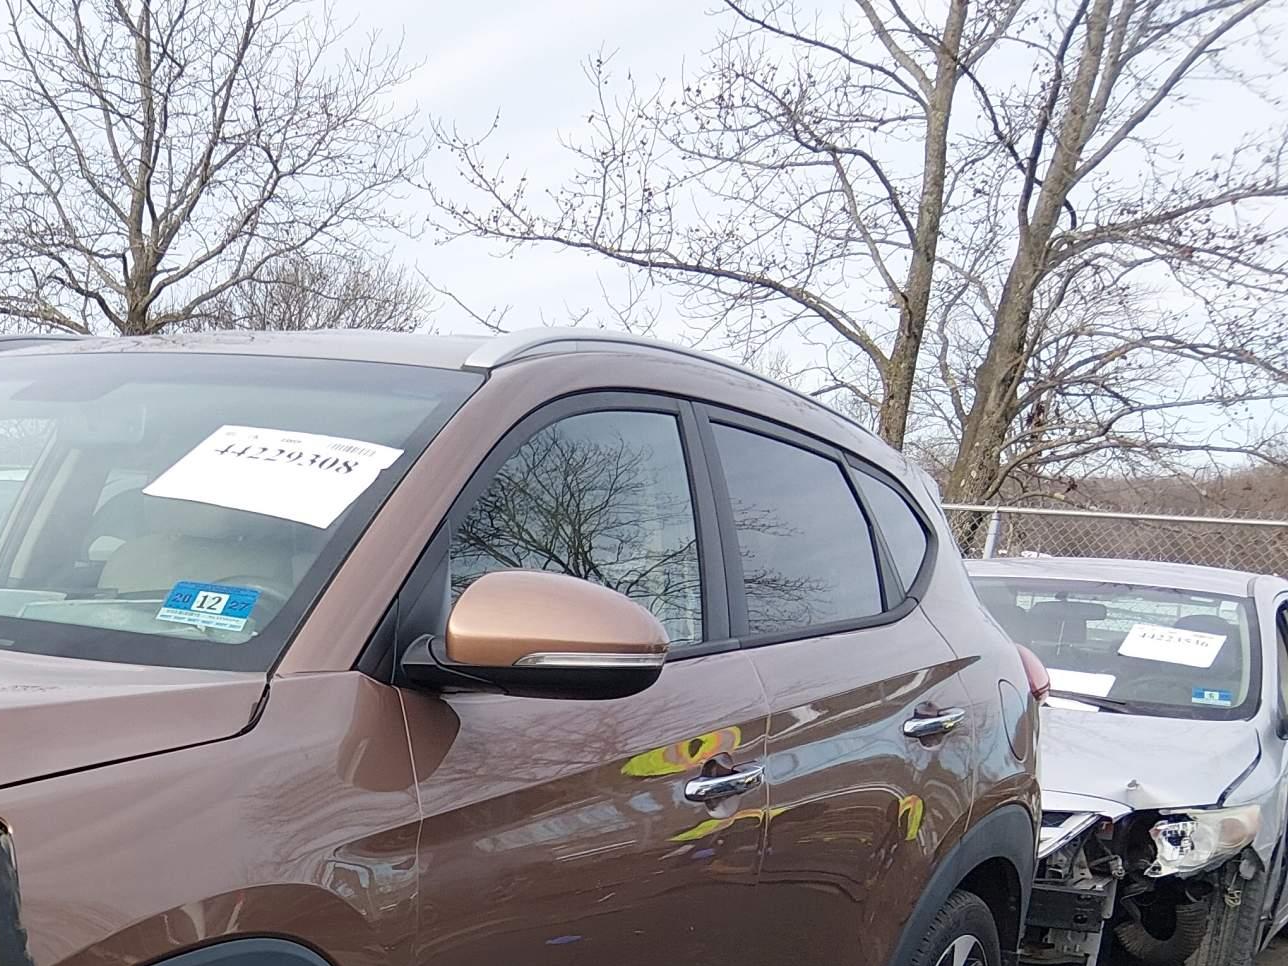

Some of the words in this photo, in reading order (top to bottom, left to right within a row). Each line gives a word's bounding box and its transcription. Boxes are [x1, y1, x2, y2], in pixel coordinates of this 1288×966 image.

[215, 444, 359, 474] 44229308
[173, 592, 192, 604] 20
[196, 594, 223, 611] 12
[228, 601, 250, 612] 27
